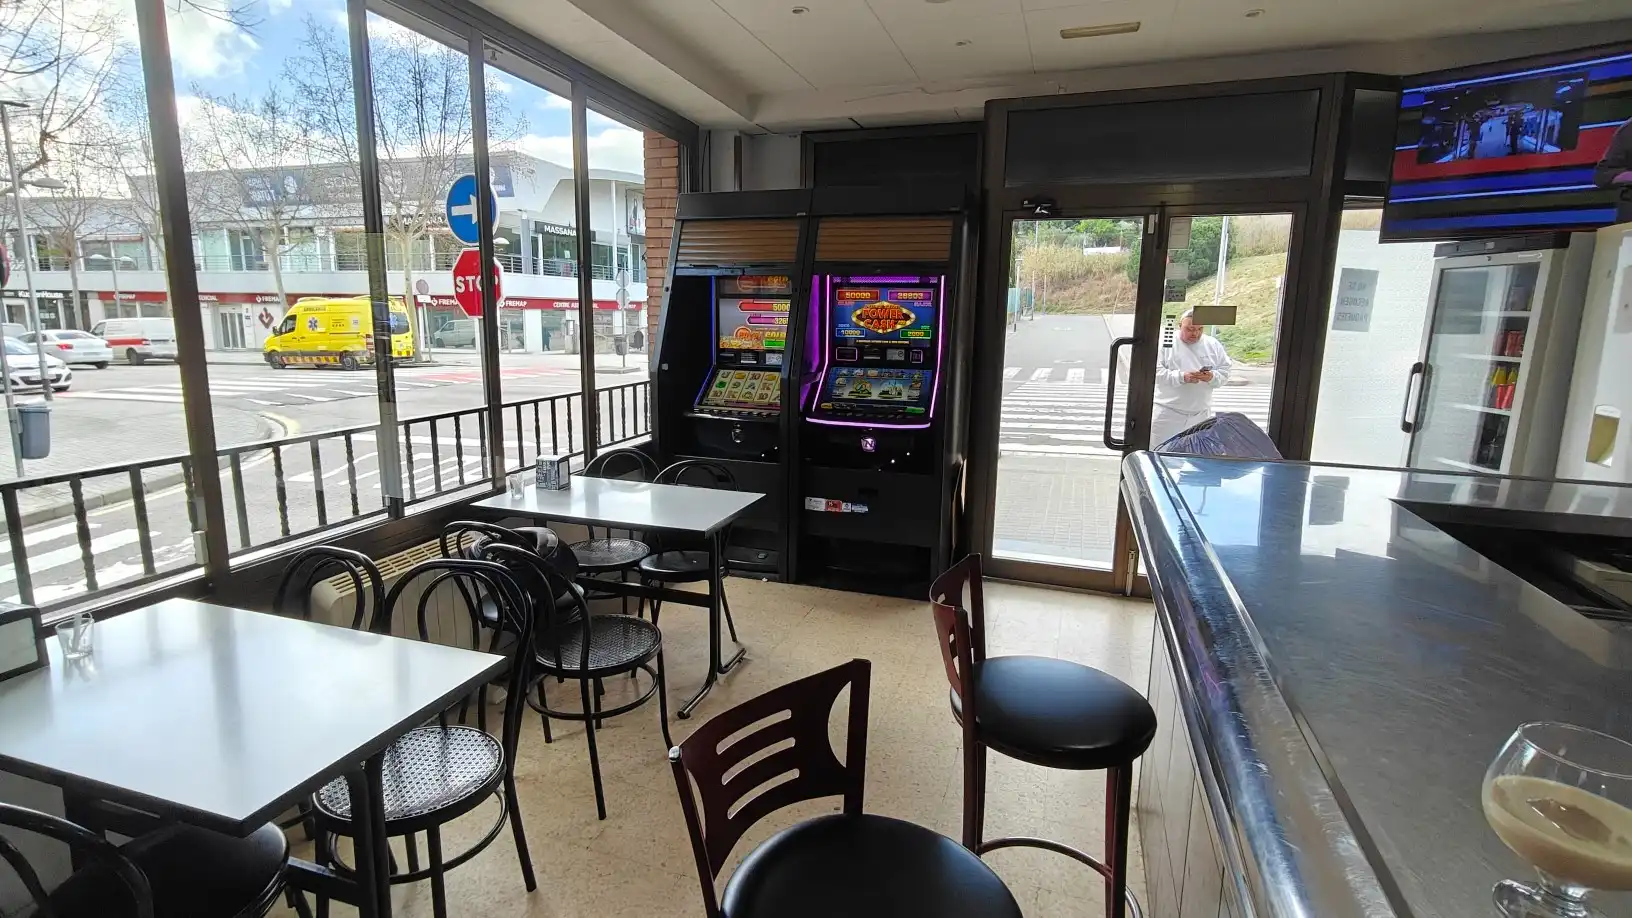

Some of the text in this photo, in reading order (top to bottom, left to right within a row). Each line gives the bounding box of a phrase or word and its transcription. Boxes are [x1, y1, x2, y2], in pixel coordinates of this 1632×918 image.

[455, 275, 498, 293] STO
[861, 308, 904, 319] POWER
[863, 319, 896, 329] CASH
